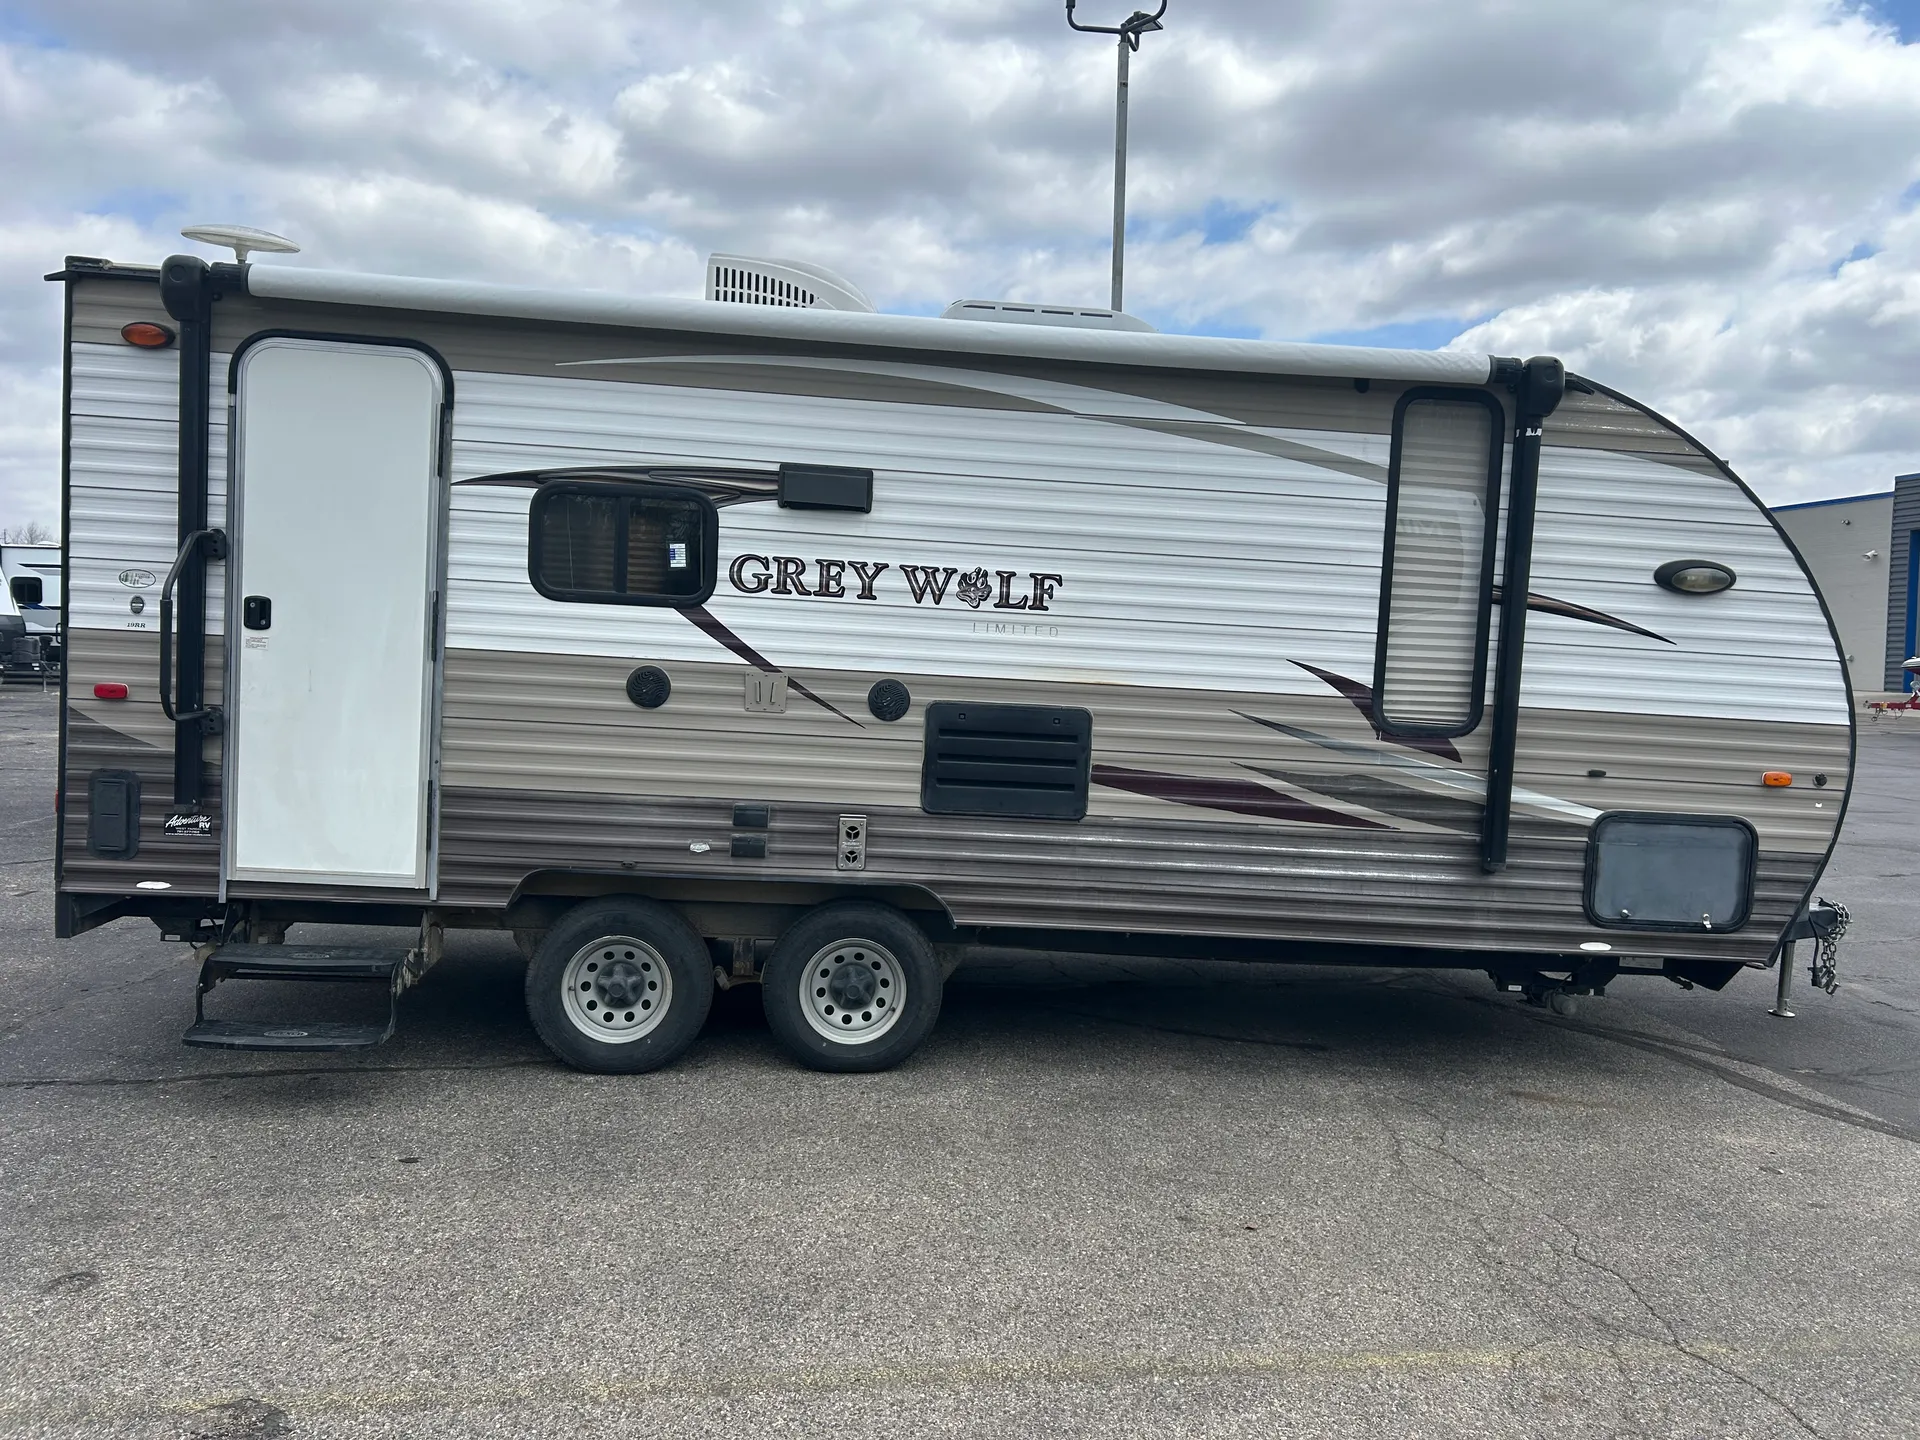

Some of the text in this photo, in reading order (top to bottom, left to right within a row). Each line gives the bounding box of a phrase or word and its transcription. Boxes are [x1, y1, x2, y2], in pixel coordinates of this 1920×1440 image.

[728, 553, 890, 601] GREY
[972, 621, 1059, 638] LIMITED
[165, 815, 211, 828] Adventure
